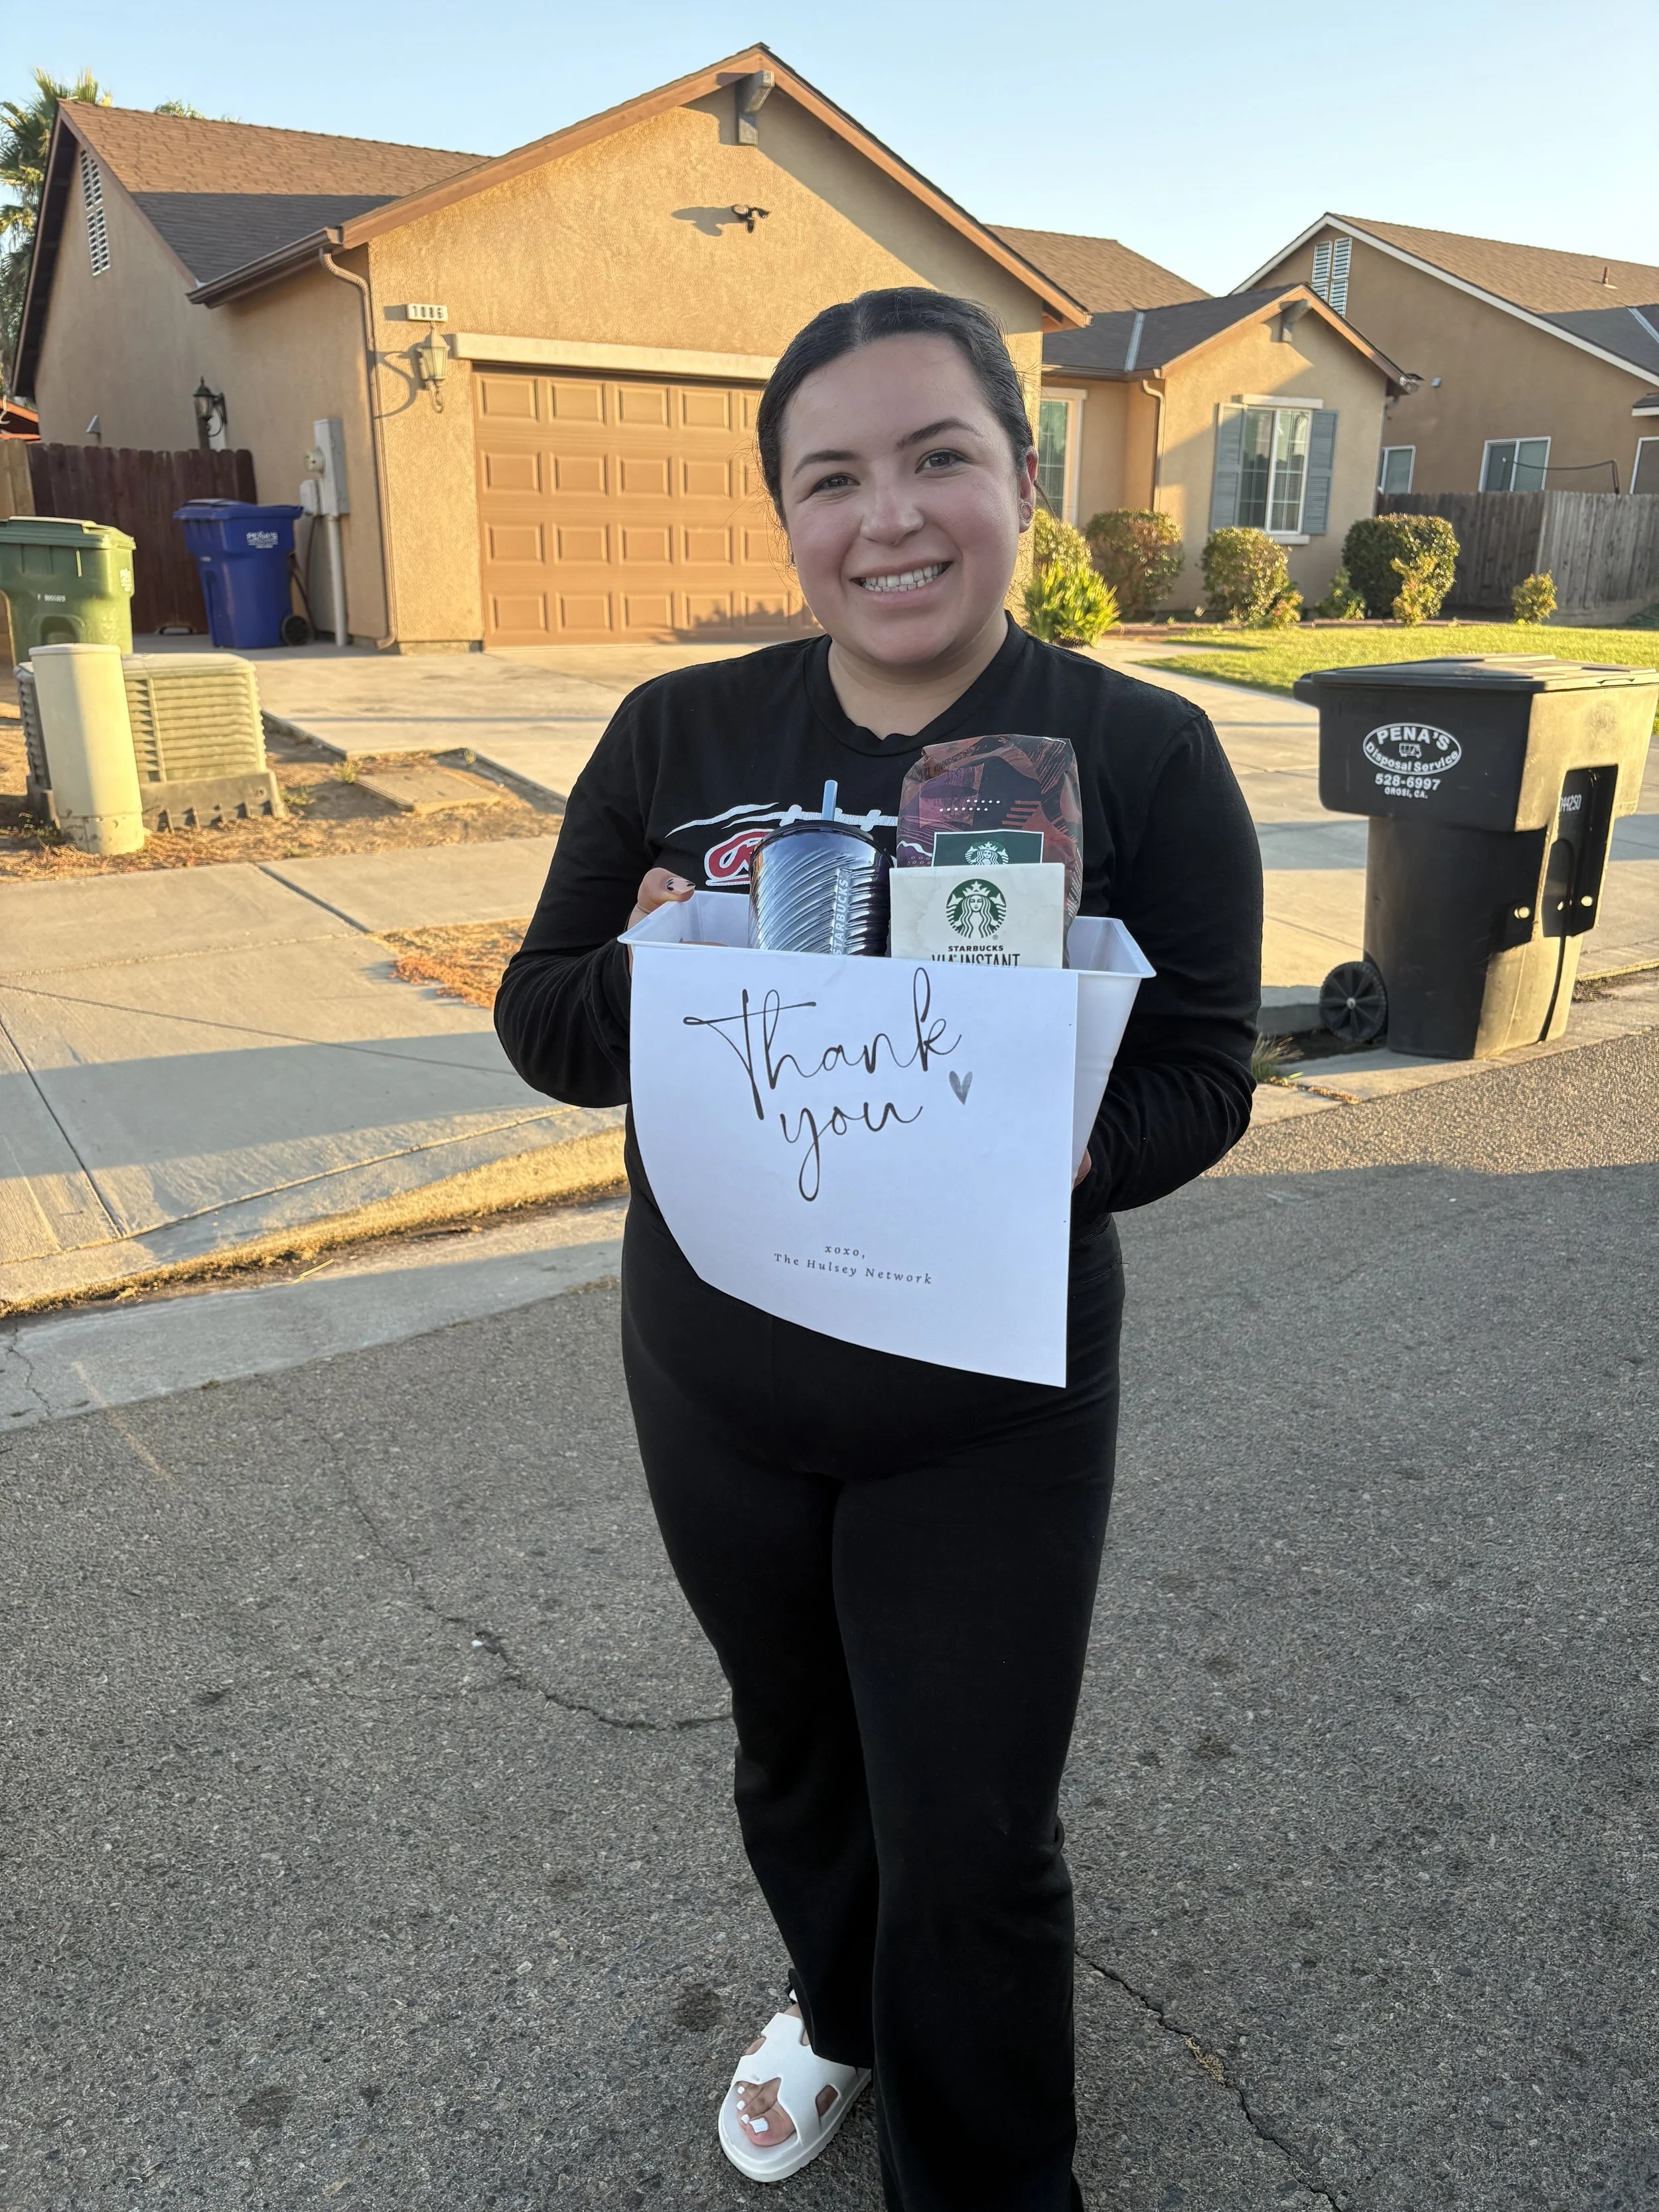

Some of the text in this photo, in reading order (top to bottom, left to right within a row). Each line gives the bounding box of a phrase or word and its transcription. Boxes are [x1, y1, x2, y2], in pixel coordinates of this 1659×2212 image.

[1376, 726, 1451, 751] PENA'S
[1365, 741, 1459, 772] Disposal Service
[1375, 773, 1441, 790] 528-6997
[832, 878, 849, 956] STARBUCKS
[683, 968, 962, 1120] Thank
[780, 1102, 923, 1202] you
[825, 1245, 865, 1260] xoxo,
[774, 1253, 932, 1284] The Hulsey Network
